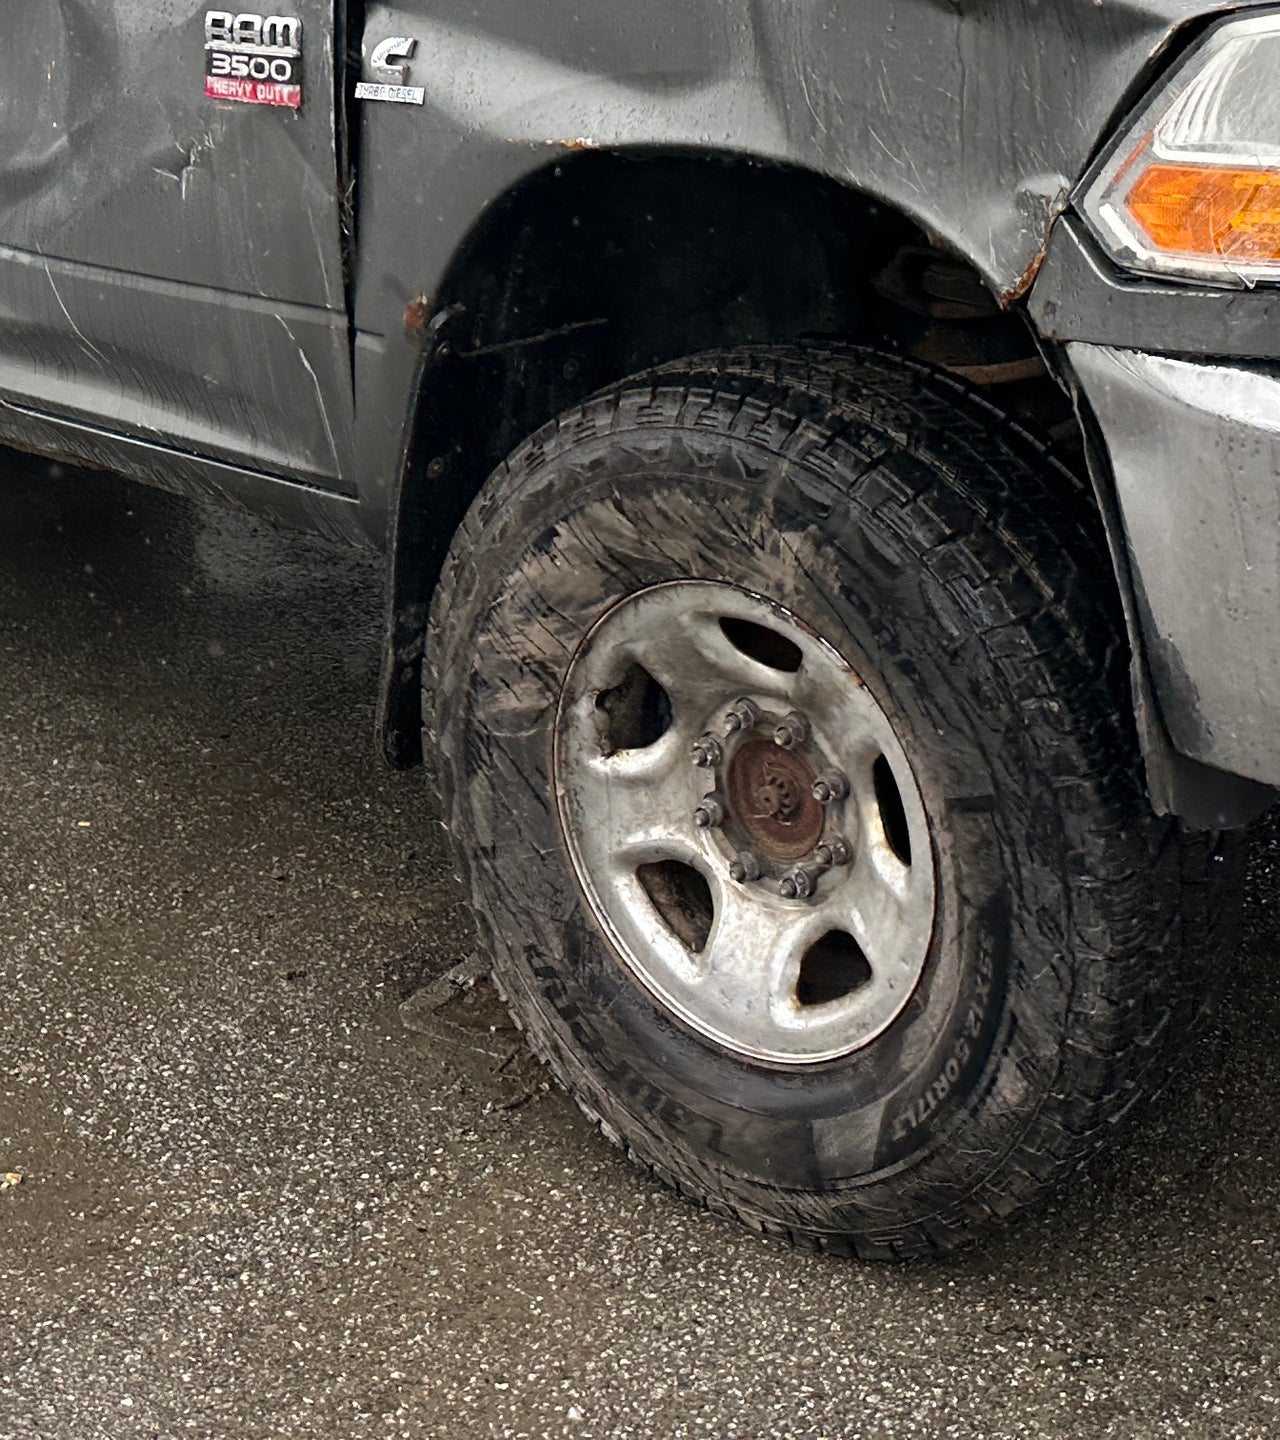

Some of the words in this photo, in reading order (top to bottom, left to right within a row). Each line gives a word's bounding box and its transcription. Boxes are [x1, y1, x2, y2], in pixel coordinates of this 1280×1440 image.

[204, 10, 301, 49] RAM
[211, 52, 292, 82] 3500
[212, 78, 253, 98] HEAVY
[256, 83, 292, 103] DUTY
